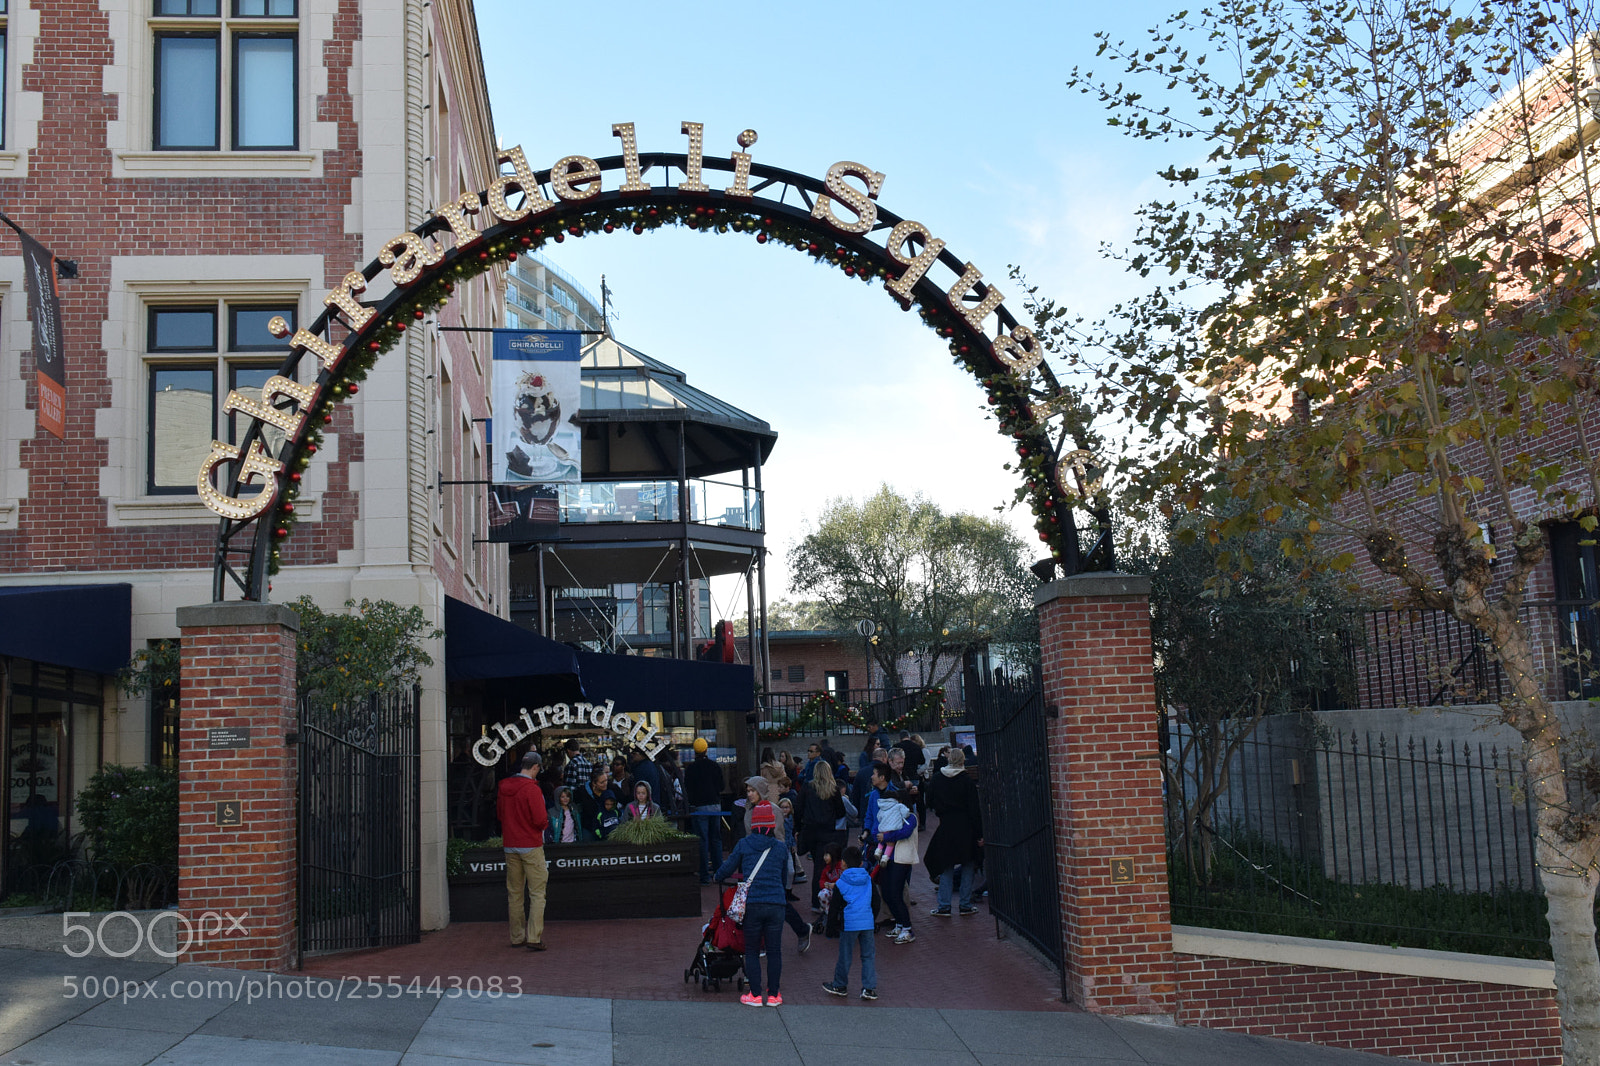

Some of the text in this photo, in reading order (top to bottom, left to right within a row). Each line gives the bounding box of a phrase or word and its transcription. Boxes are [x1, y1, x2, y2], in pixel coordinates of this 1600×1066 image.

[197, 121, 758, 521] Ghirardelli
[10, 743, 55, 757] MPEIAL
[472, 699, 671, 767] Ghirardelli
[8, 776, 55, 788] COCOA
